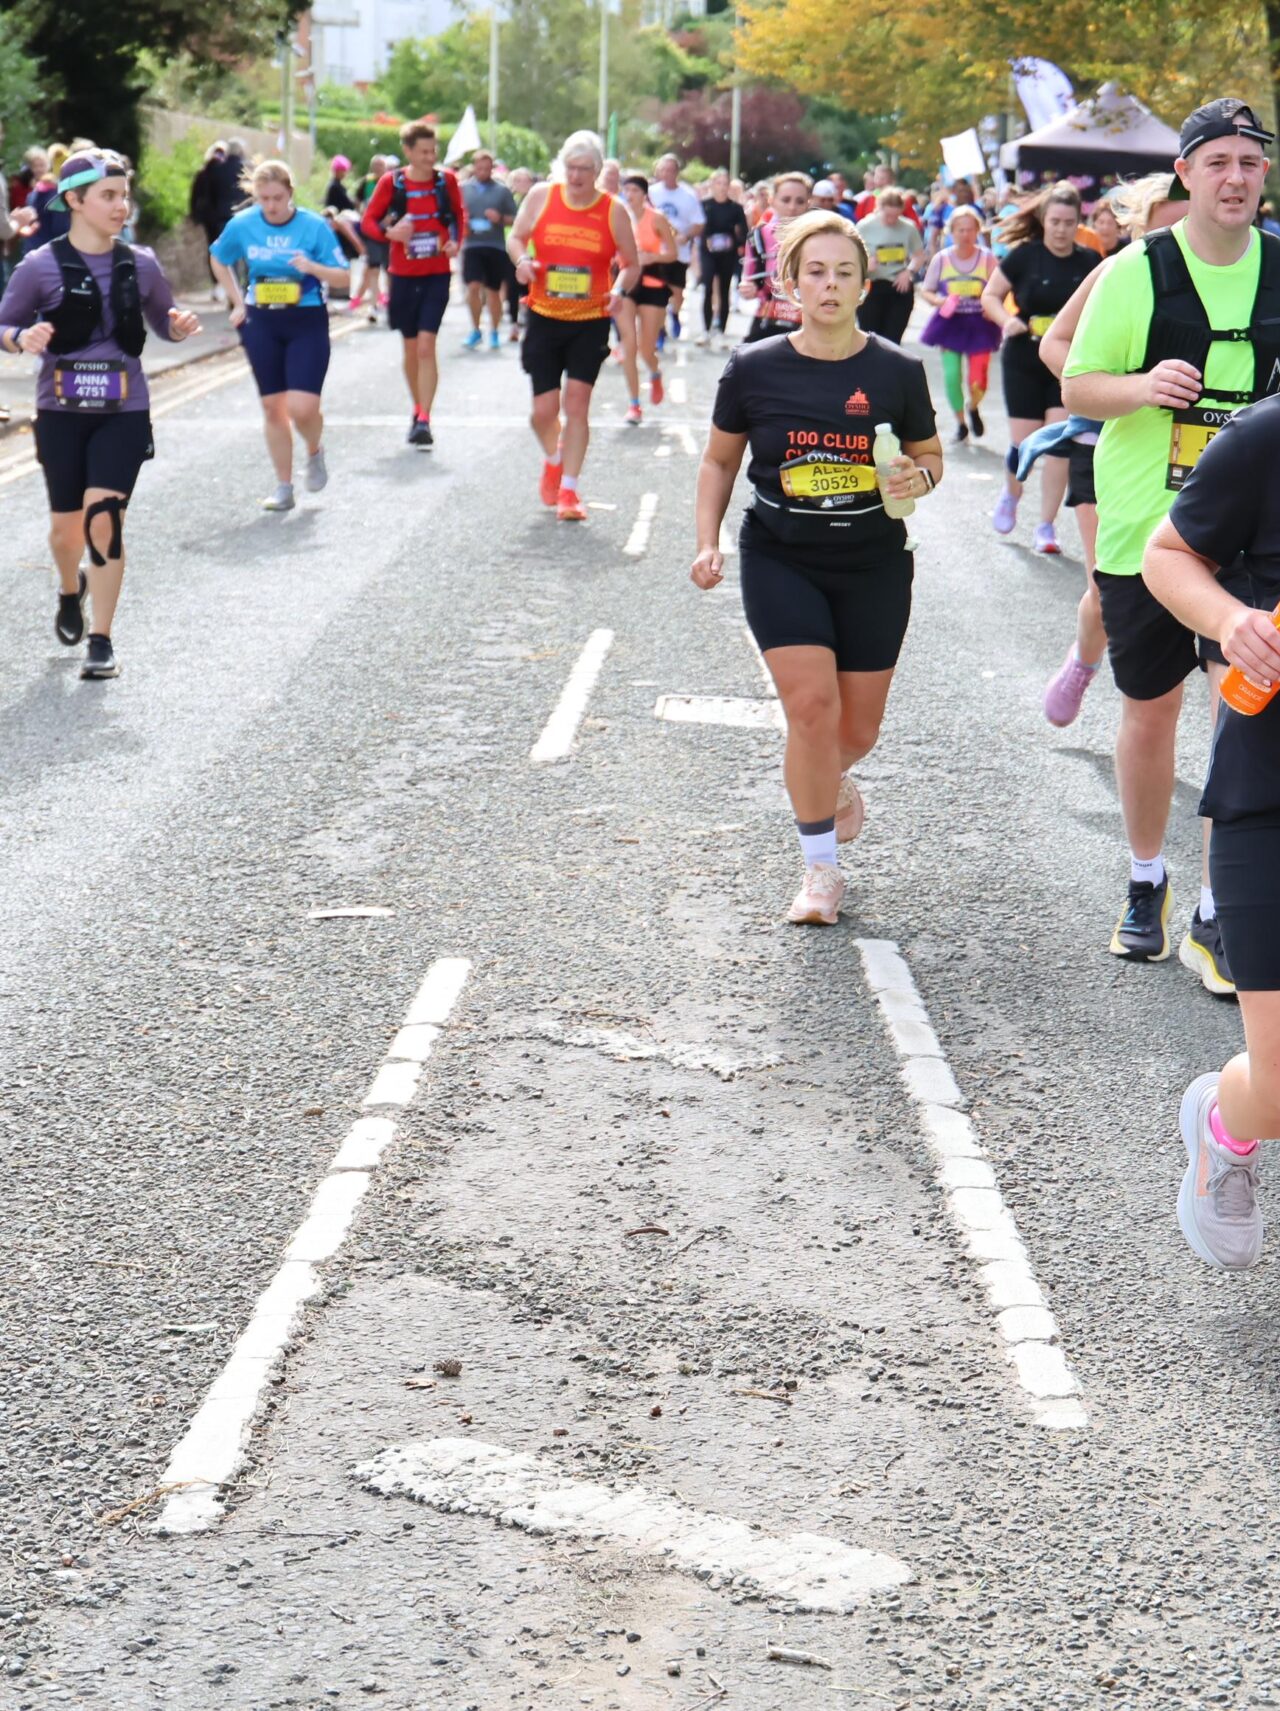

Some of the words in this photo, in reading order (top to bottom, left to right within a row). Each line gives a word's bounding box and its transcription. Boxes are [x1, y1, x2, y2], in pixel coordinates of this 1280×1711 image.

[73, 362, 109, 372] OYSHO
[73, 374, 109, 386] ANNA
[75, 386, 107, 398] 4751
[787, 431, 819, 446] 100
[823, 433, 869, 450] CLUB
[810, 475, 860, 493] 30529
